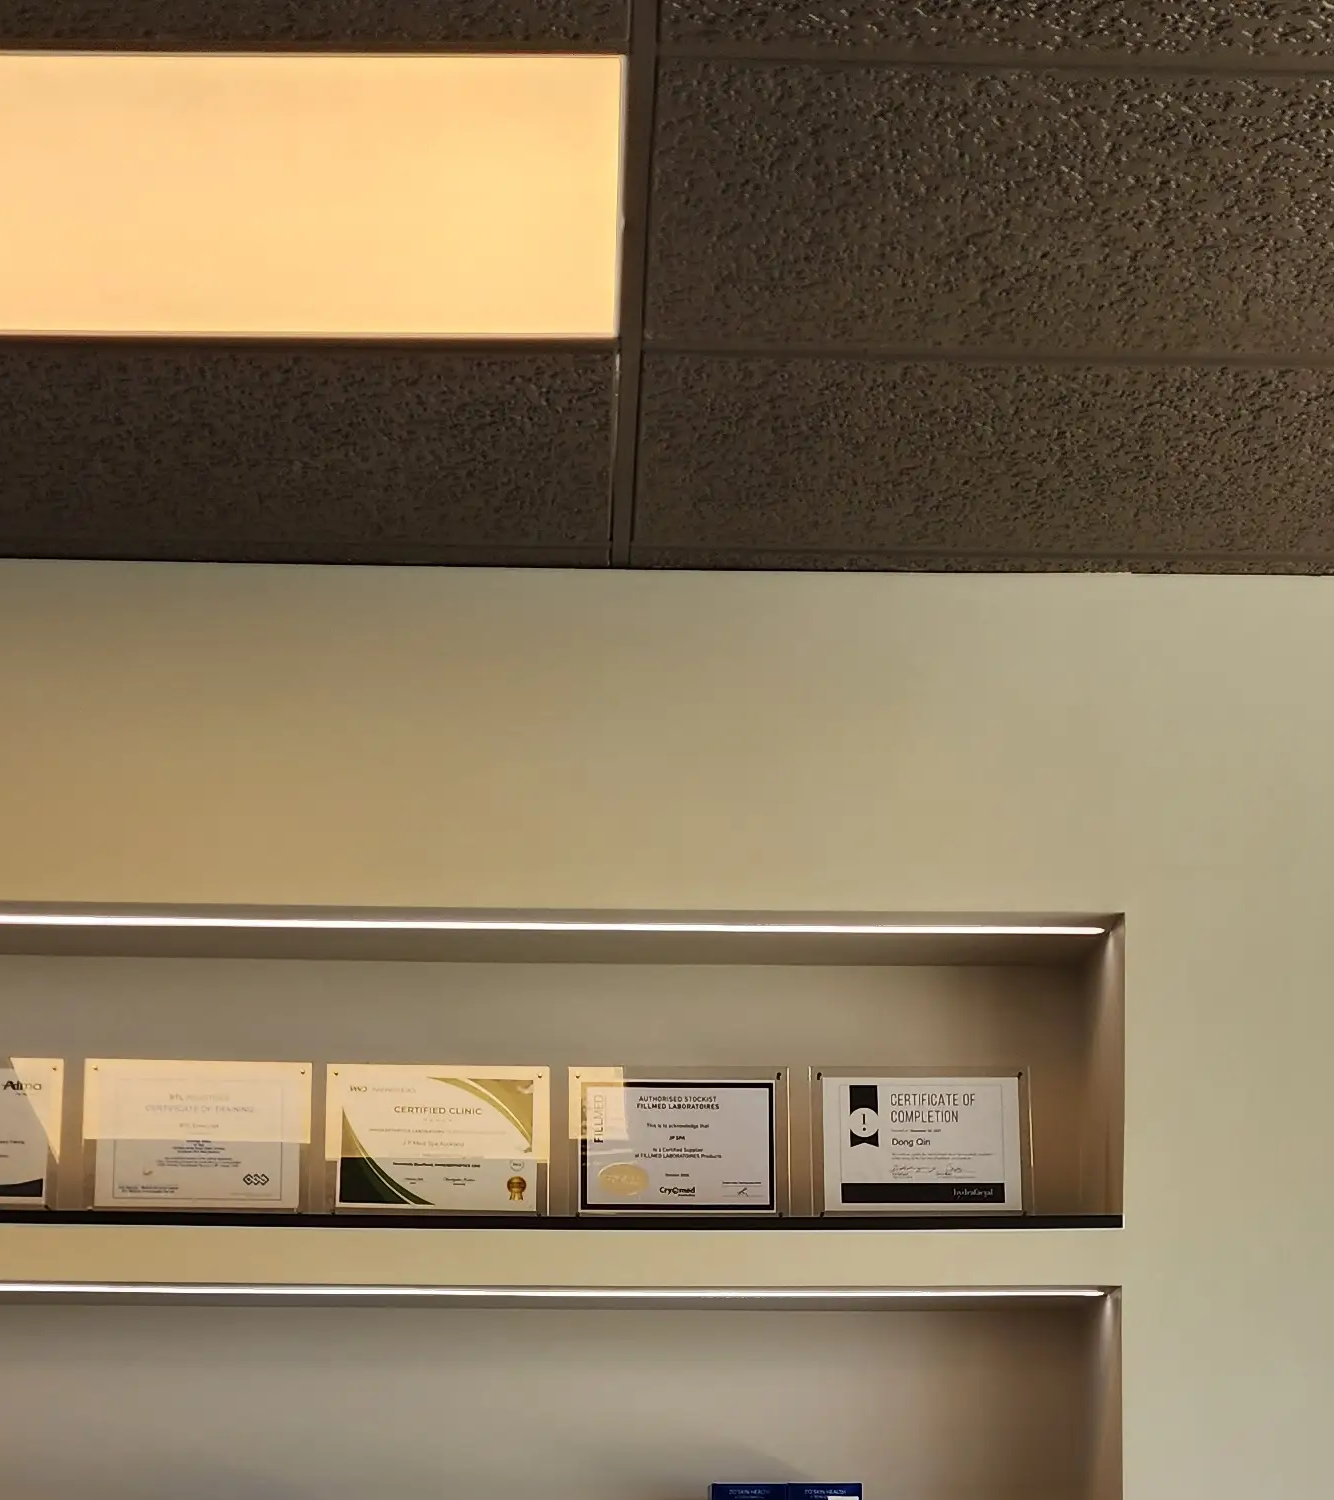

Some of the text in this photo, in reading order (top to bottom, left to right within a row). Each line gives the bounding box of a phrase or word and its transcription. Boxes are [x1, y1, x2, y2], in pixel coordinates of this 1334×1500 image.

[890, 1093, 976, 1106] CERTIFICATE OF
[394, 1105, 483, 1115] CERTIFIED CLINIC
[890, 1110, 959, 1123] COMPLETION
[891, 1138, 931, 1147] Dong Qin
